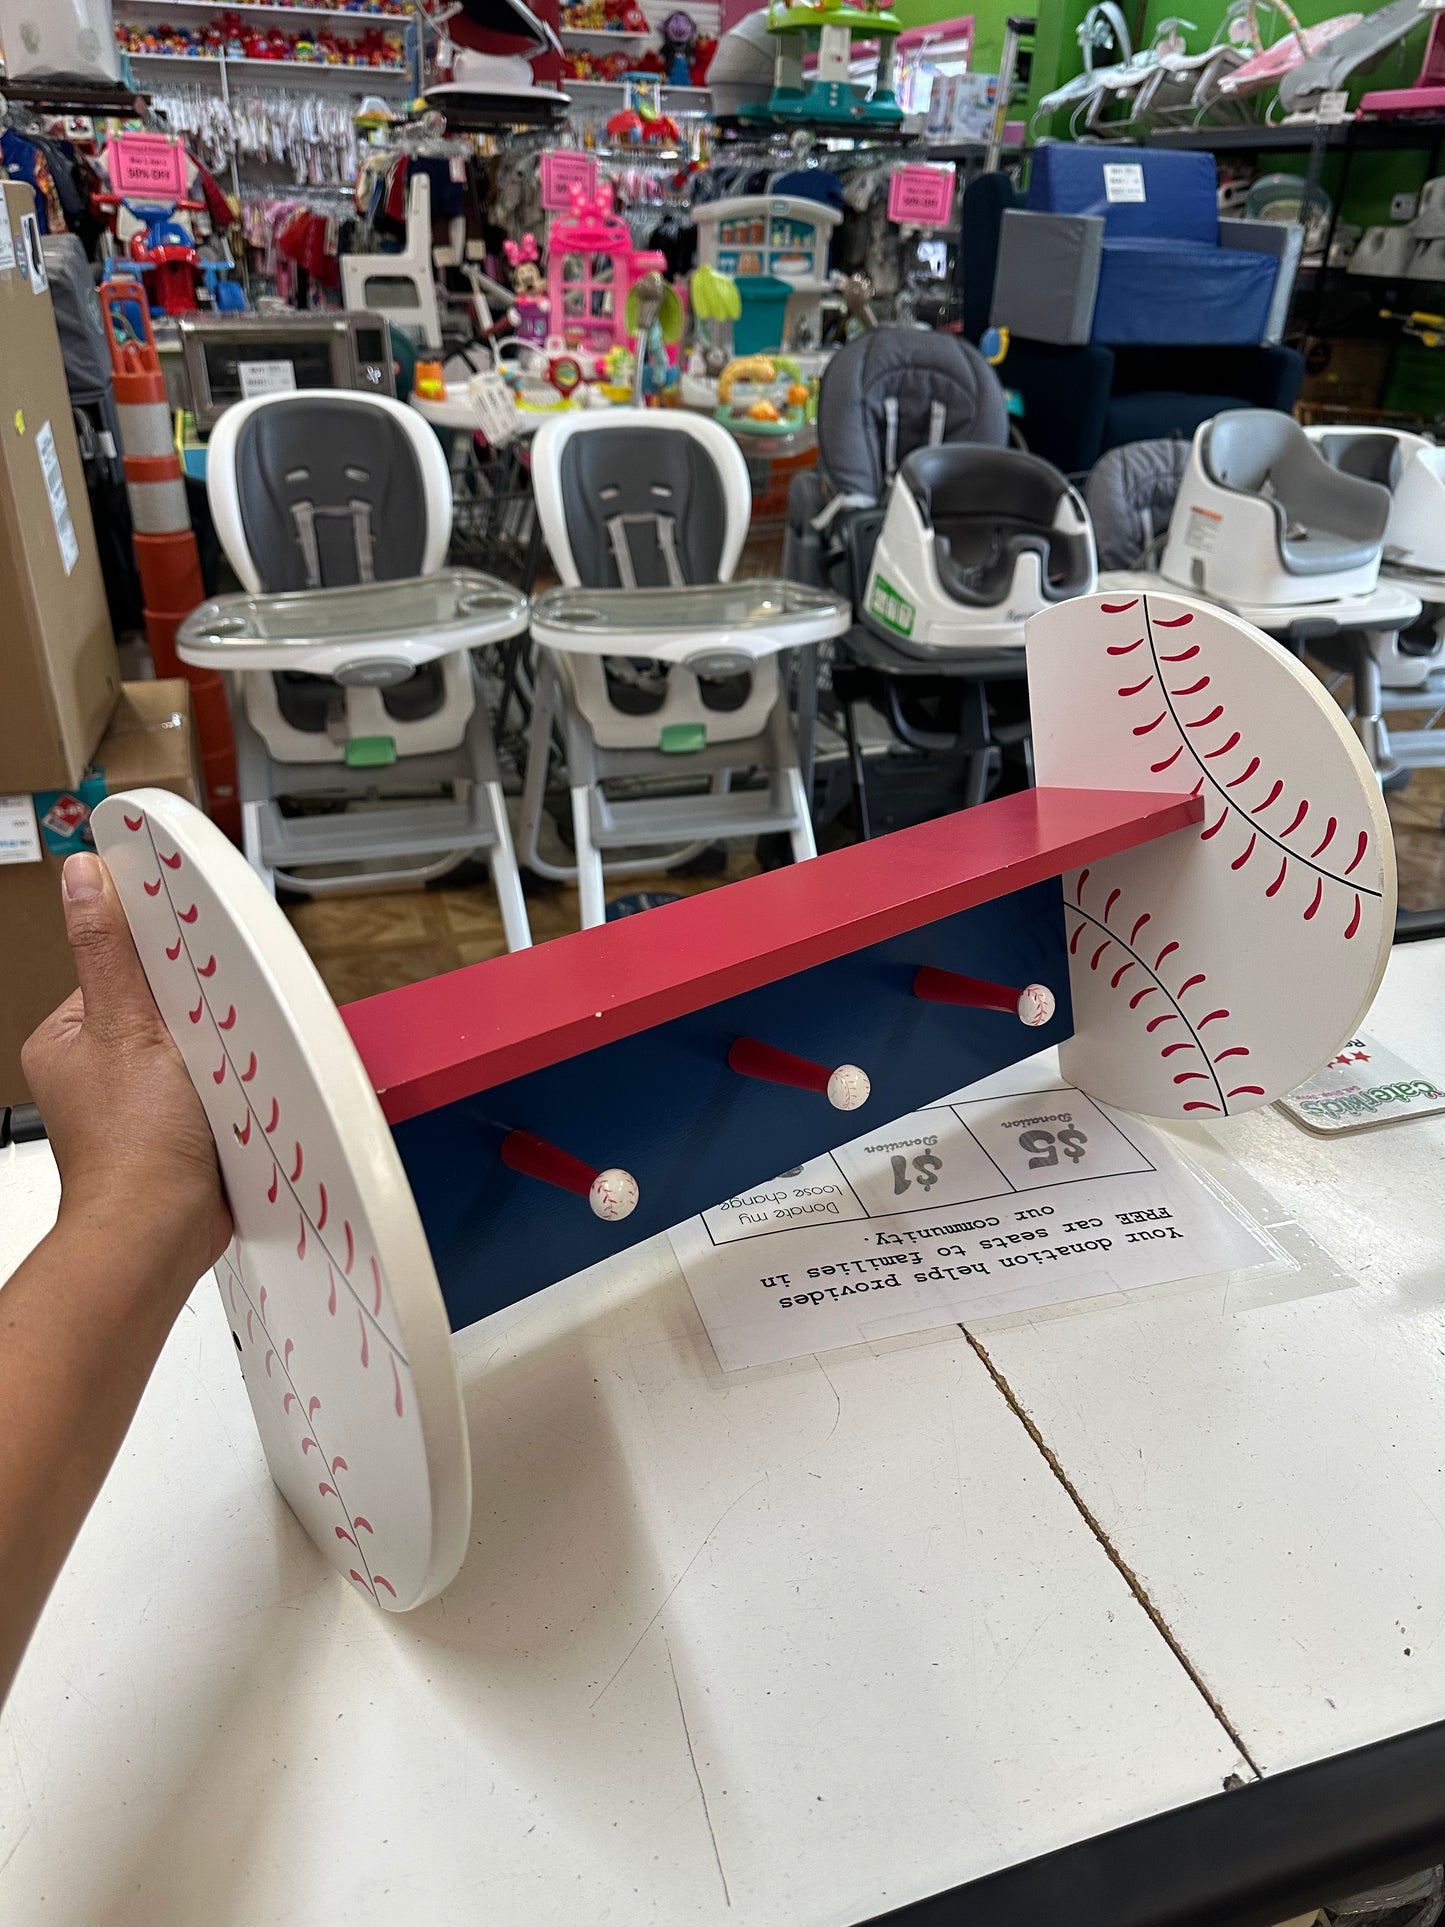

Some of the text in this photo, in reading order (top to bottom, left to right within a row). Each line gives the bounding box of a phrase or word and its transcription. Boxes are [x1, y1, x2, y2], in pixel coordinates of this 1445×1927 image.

[1001, 1112, 1073, 1129] Donation
[864, 1134, 938, 1153] Donation
[1018, 1123, 1088, 1170] $5
[890, 1148, 943, 1195] $1
[719, 1184, 844, 1211] loose change
[738, 1202, 840, 1225] Donate my
[864, 1206, 1055, 1246] our community.
[760, 1207, 1173, 1289] FREE car seats to families in
[779, 1226, 1184, 1308] Your donation helps provides
